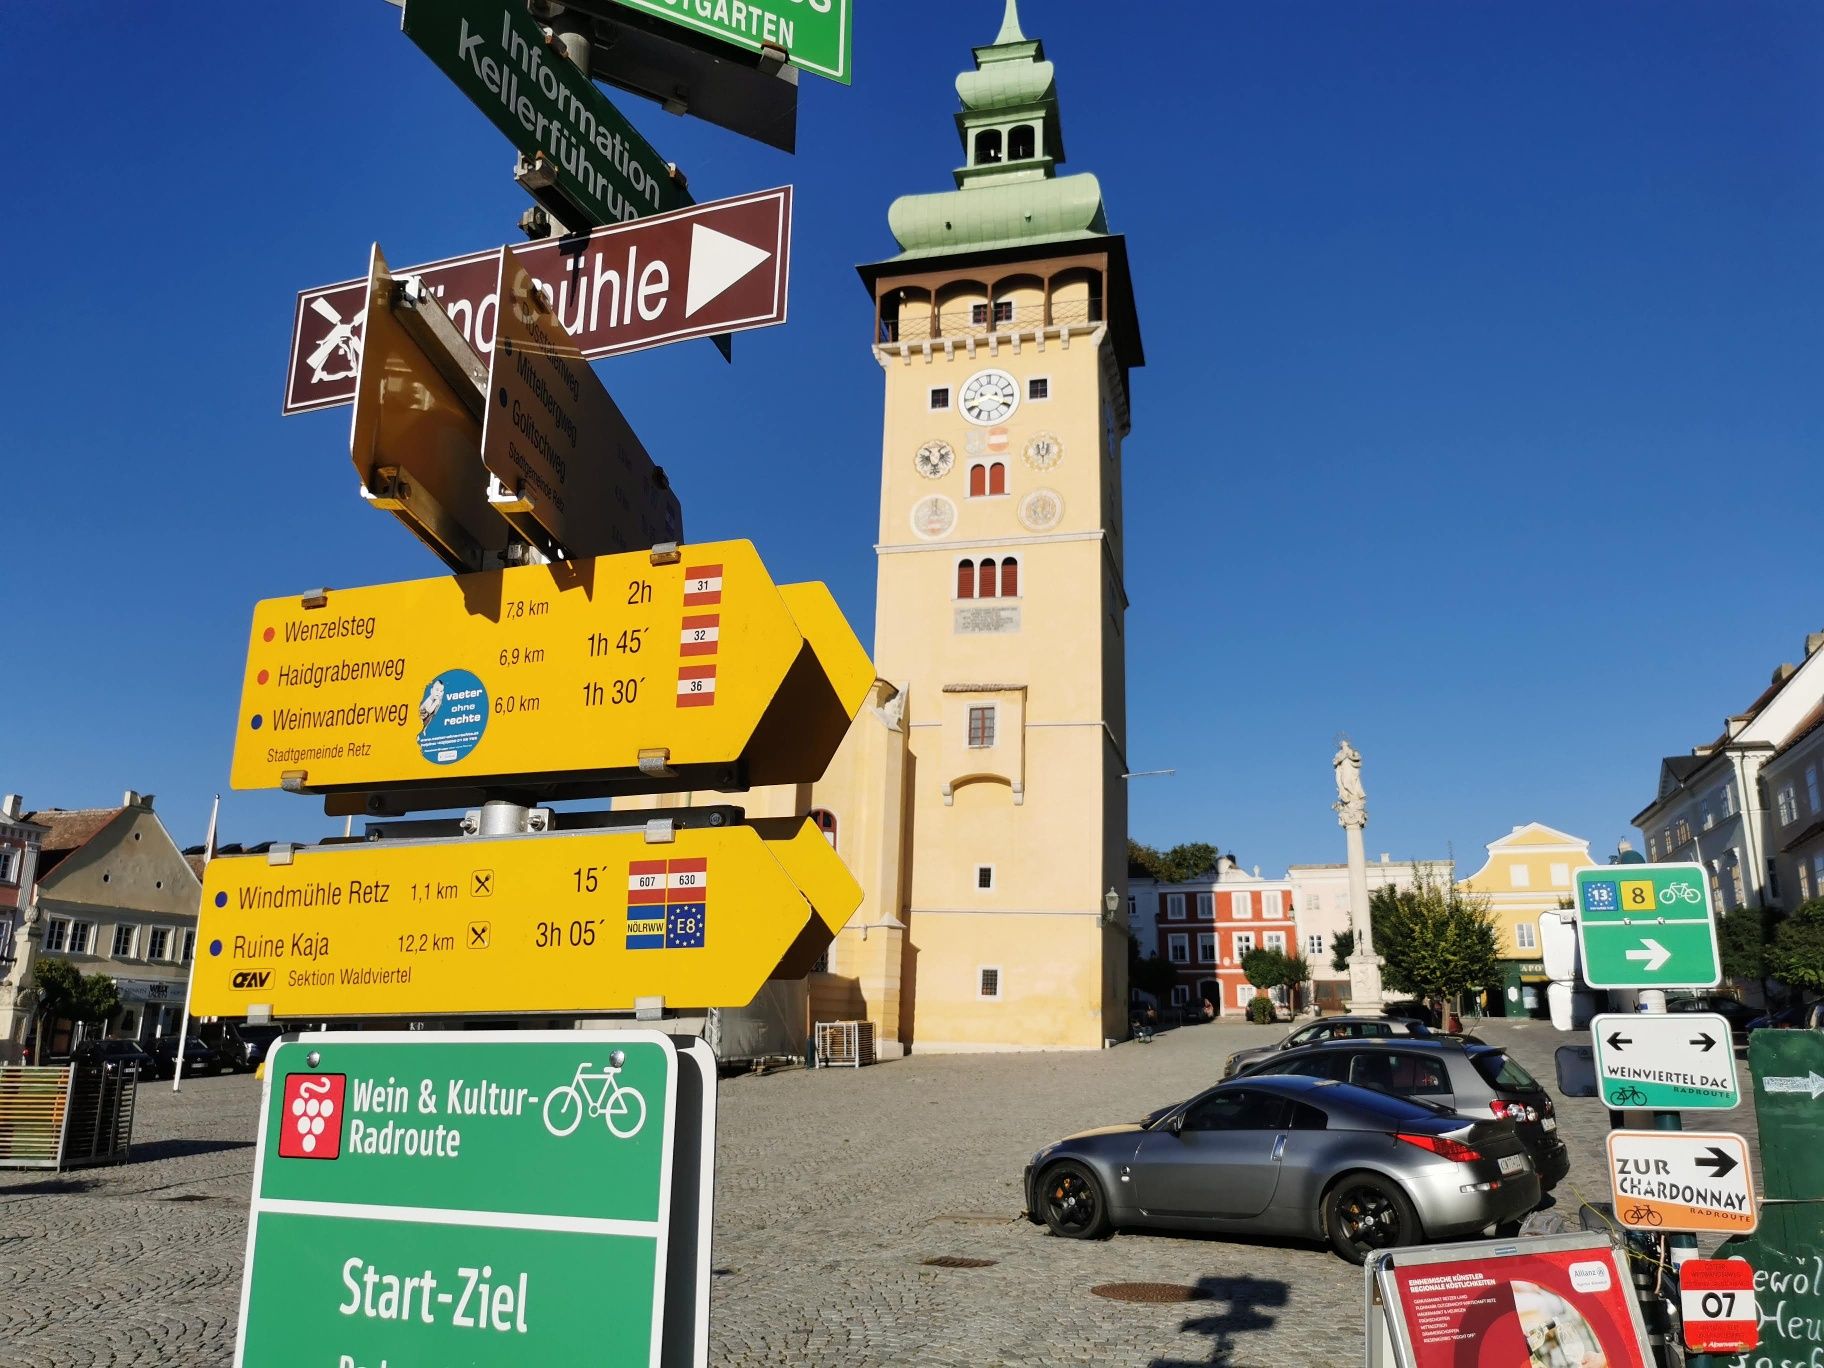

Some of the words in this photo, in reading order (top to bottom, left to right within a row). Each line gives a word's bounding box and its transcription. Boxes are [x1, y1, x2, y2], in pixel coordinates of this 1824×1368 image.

[664, 0, 794, 48] GARTEN
[501, 9, 660, 210] Information
[697, 580, 709, 591] 31
[285, 616, 376, 643] Wenzelsteg
[506, 601, 525, 619] 7,8
[529, 600, 549, 616] km
[627, 580, 652, 605] 2h
[694, 630, 706, 641] 32
[278, 657, 405, 688] Haidgrabenweg
[499, 648, 520, 666] 6,9
[524, 647, 545, 664] km
[587, 633, 608, 657] 1h
[446, 689, 483, 700] vaeter
[690, 681, 702, 692] 36
[272, 702, 409, 731] Weinwanderweg
[494, 696, 515, 714] 6,0
[519, 694, 540, 712] km
[583, 682, 604, 706] 1h
[451, 704, 476, 712] ohne
[444, 714, 481, 726] rechte
[267, 742, 344, 764] Stadtgemeinde
[348, 742, 372, 758] Retz
[639, 876, 656, 887] 607
[678, 874, 696, 886] 630
[238, 882, 342, 910] Windmühle
[349, 881, 390, 904] Retz
[410, 884, 431, 904] 1,1
[436, 882, 458, 899] km
[1592, 889, 1608, 901] 13
[1631, 887, 1646, 904] 8
[627, 921, 664, 933] NÖLRWW
[676, 918, 695, 934] E8
[233, 935, 284, 959] Ruine
[291, 932, 329, 962] Kaja
[398, 934, 427, 954] 12,2
[432, 933, 454, 951] km
[535, 922, 561, 947] 3h
[288, 969, 335, 987] Sektion
[340, 966, 412, 985] Waldviertel
[1607, 1065, 1696, 1087] WEINVIERTEL
[1700, 1075, 1728, 1090] DAC
[353, 1077, 408, 1114] Wein
[418, 1079, 437, 1114] &
[446, 1079, 539, 1117] Kultur-
[1673, 1086, 1731, 1099] RADROUTE
[348, 1120, 461, 1158] Radroute
[1616, 1158, 1671, 1175] ZUR
[1619, 1176, 1747, 1211] CHARDONNAY
[1690, 1207, 1751, 1223] RADROUTE
[1728, 1255, 1823, 1296] ewöl
[339, 1256, 528, 1333] Start-Ziel
[1701, 1292, 1736, 1318] 07
